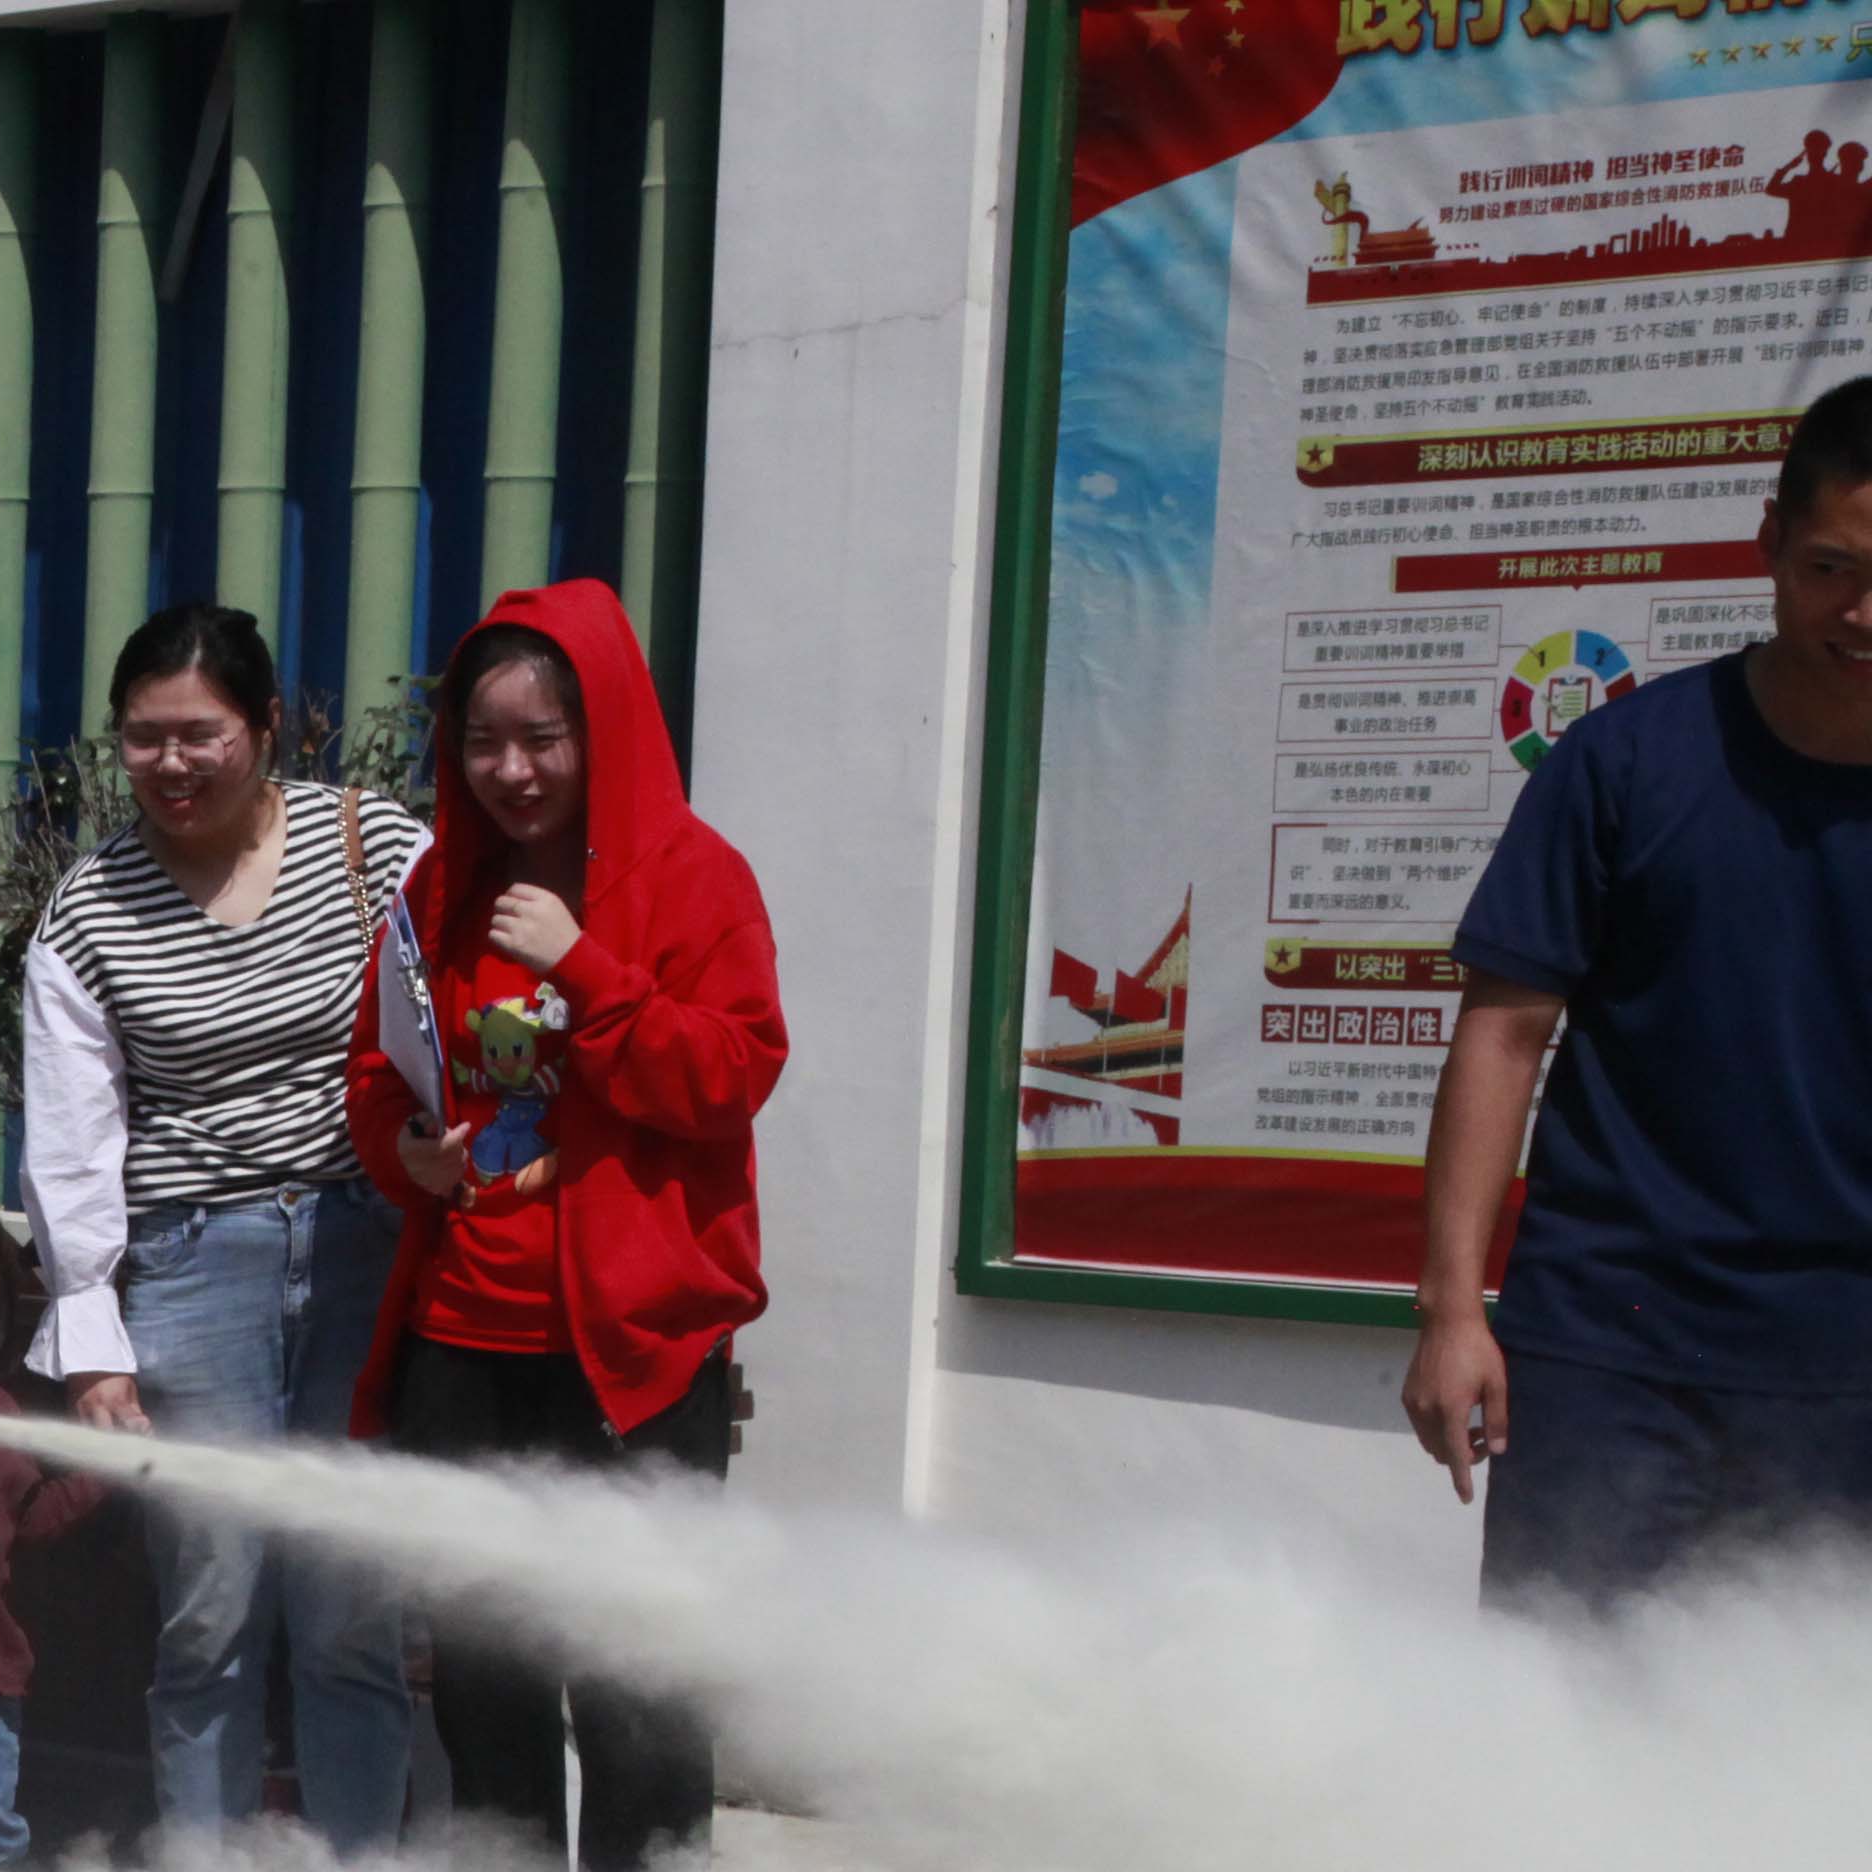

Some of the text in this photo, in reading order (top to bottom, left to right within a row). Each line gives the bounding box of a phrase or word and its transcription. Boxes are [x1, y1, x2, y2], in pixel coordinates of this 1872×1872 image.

[1459, 144, 1745, 195] 践行训词精神 担当神圣使命
[1656, 604, 1776, 624] 是巩固深化不忘
[1265, 1008, 1440, 1042] 突出政治性
[1288, 1060, 1443, 1081] 以习近平新时代中国特
